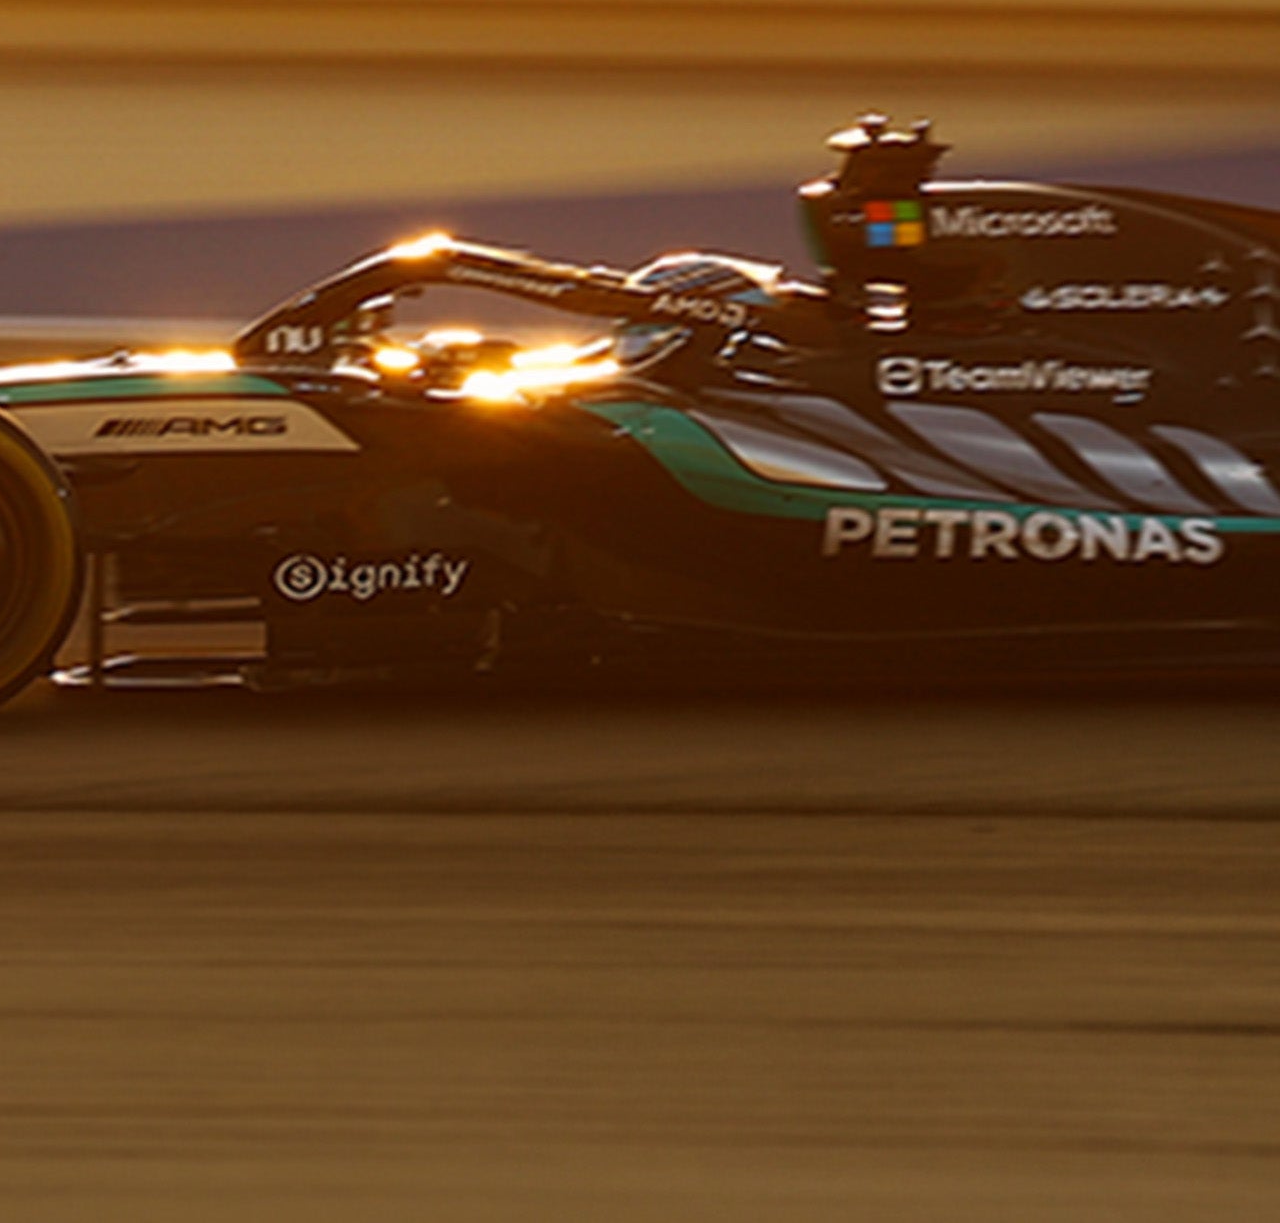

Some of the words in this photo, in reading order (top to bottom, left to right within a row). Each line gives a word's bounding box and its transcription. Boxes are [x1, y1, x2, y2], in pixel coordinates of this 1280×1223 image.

[930, 205, 1118, 237] Microsoft
[922, 359, 1152, 391] TeamViewer
[157, 416, 288, 437] AMG
[822, 507, 1225, 564] PETRONAS
